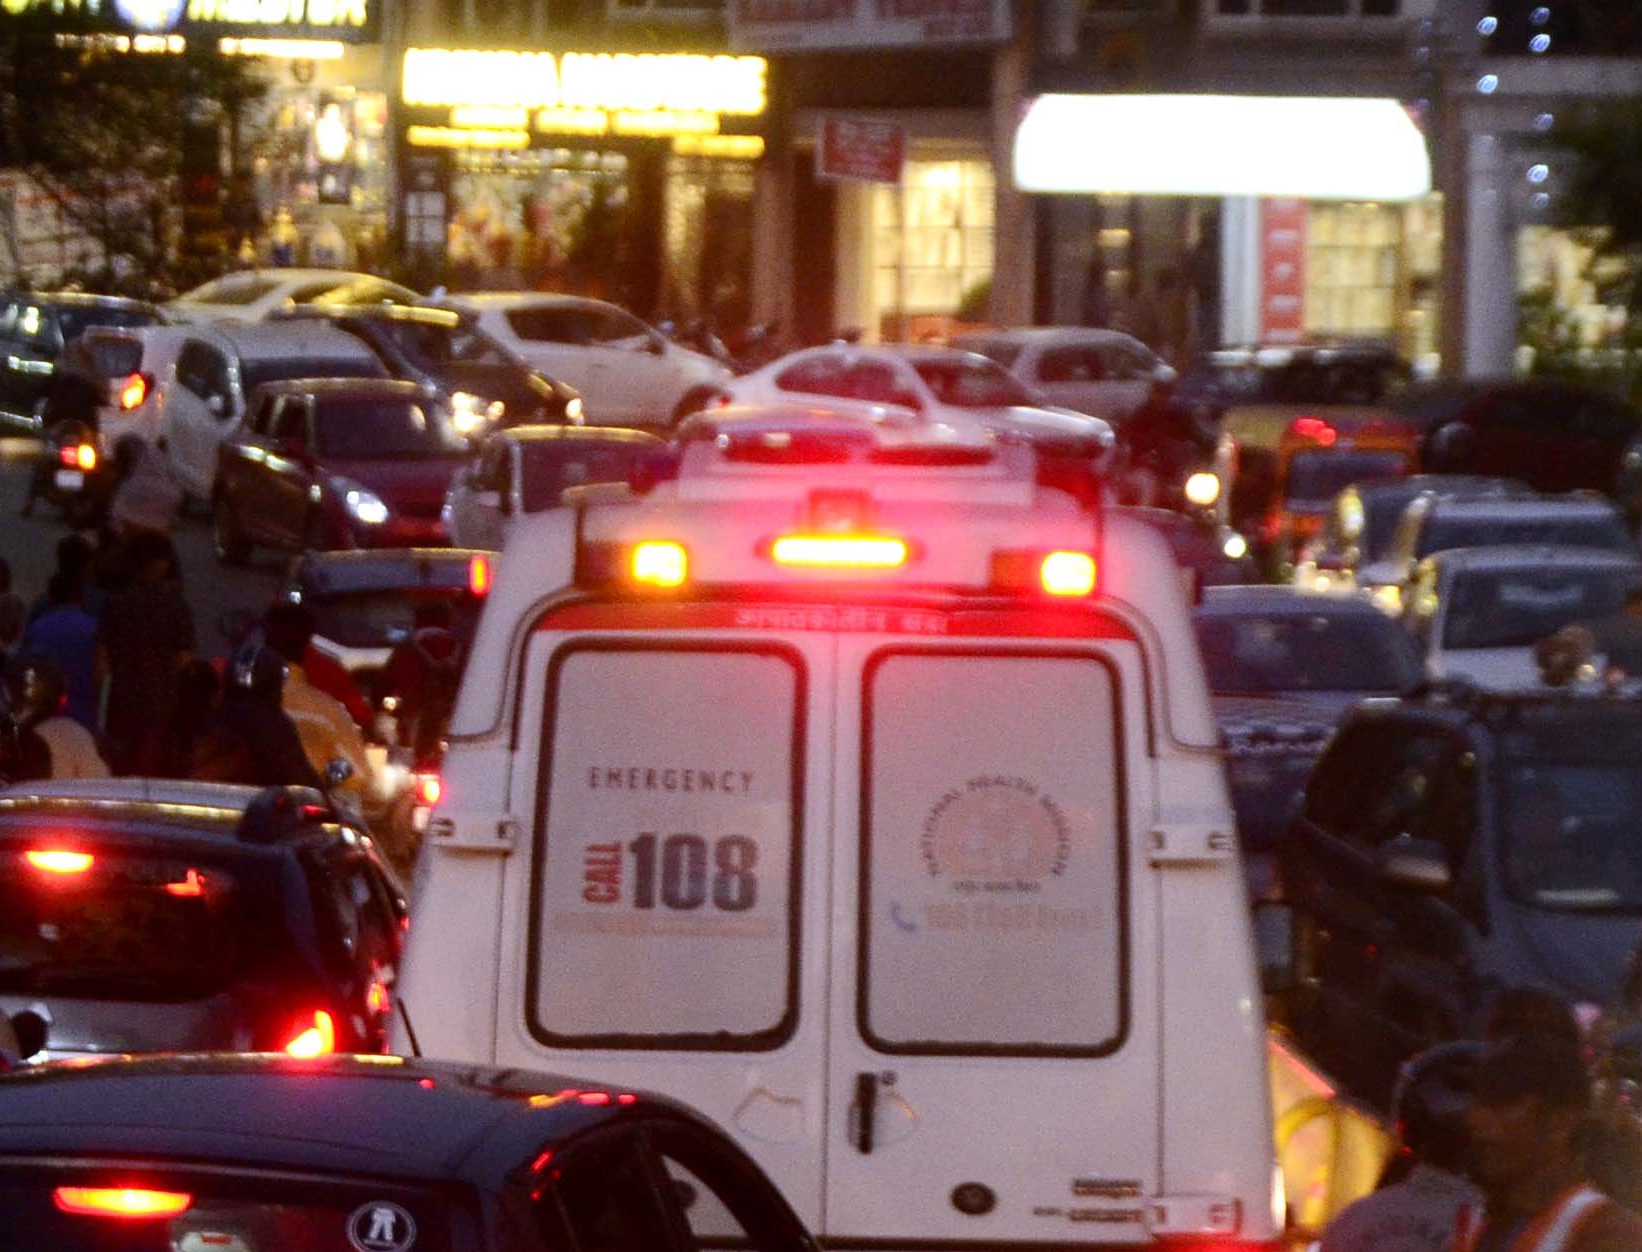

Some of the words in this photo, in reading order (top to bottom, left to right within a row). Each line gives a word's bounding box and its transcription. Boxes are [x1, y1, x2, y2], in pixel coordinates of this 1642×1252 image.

[587, 766, 755, 793] EMERGENCY
[582, 841, 622, 904] CALL
[628, 832, 759, 912] 108
